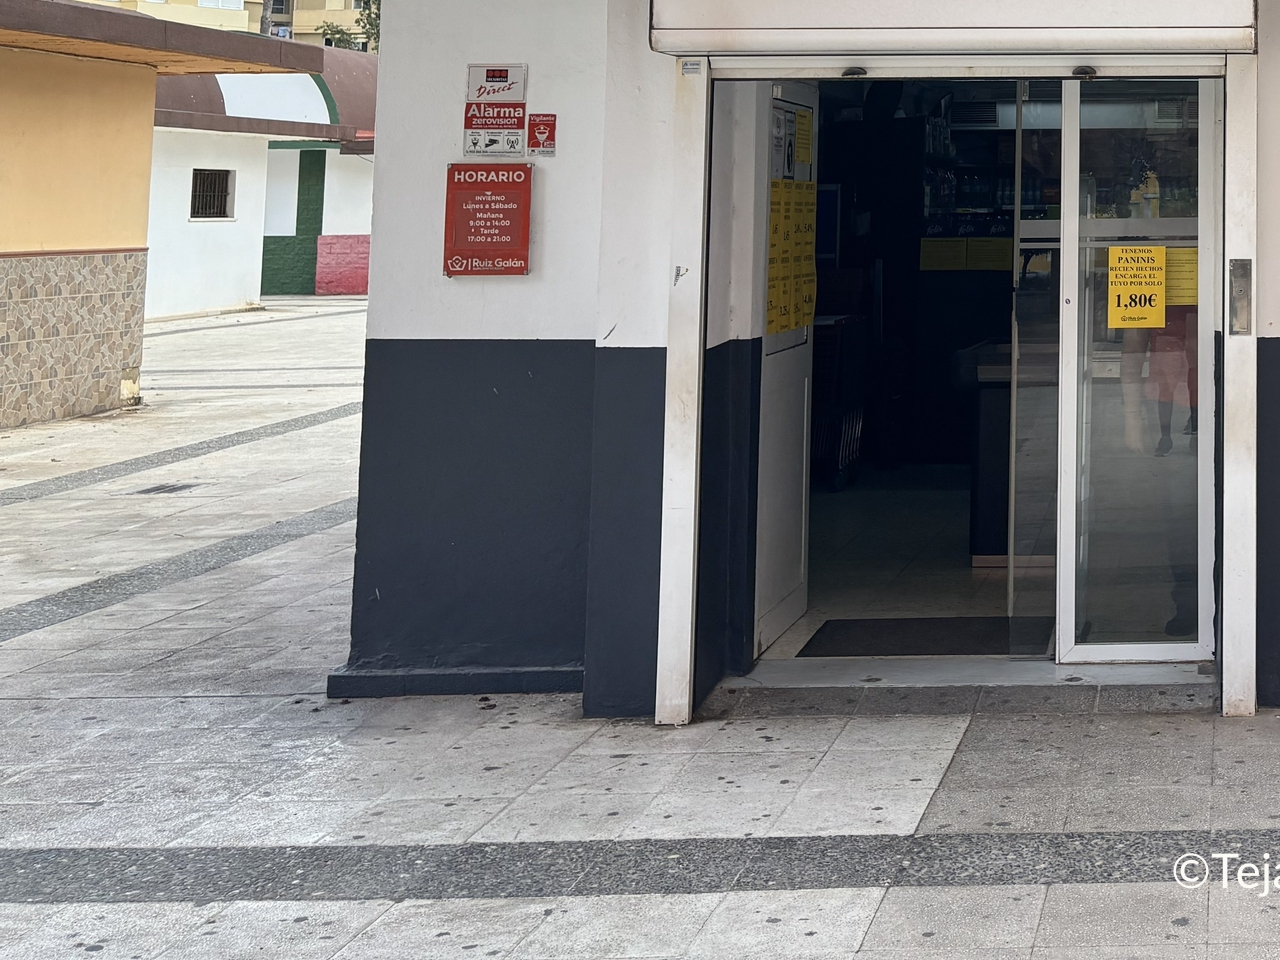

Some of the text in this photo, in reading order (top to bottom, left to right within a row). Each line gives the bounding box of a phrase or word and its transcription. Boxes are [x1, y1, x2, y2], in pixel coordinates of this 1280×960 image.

[476, 81, 518, 98] Direct
[467, 104, 523, 117] Alarma
[454, 171, 525, 182] HORARIO
[472, 258, 524, 267] Ruiz Galán
[1118, 256, 1155, 264] PANINIS
[1115, 293, 1157, 310] 1,80€
